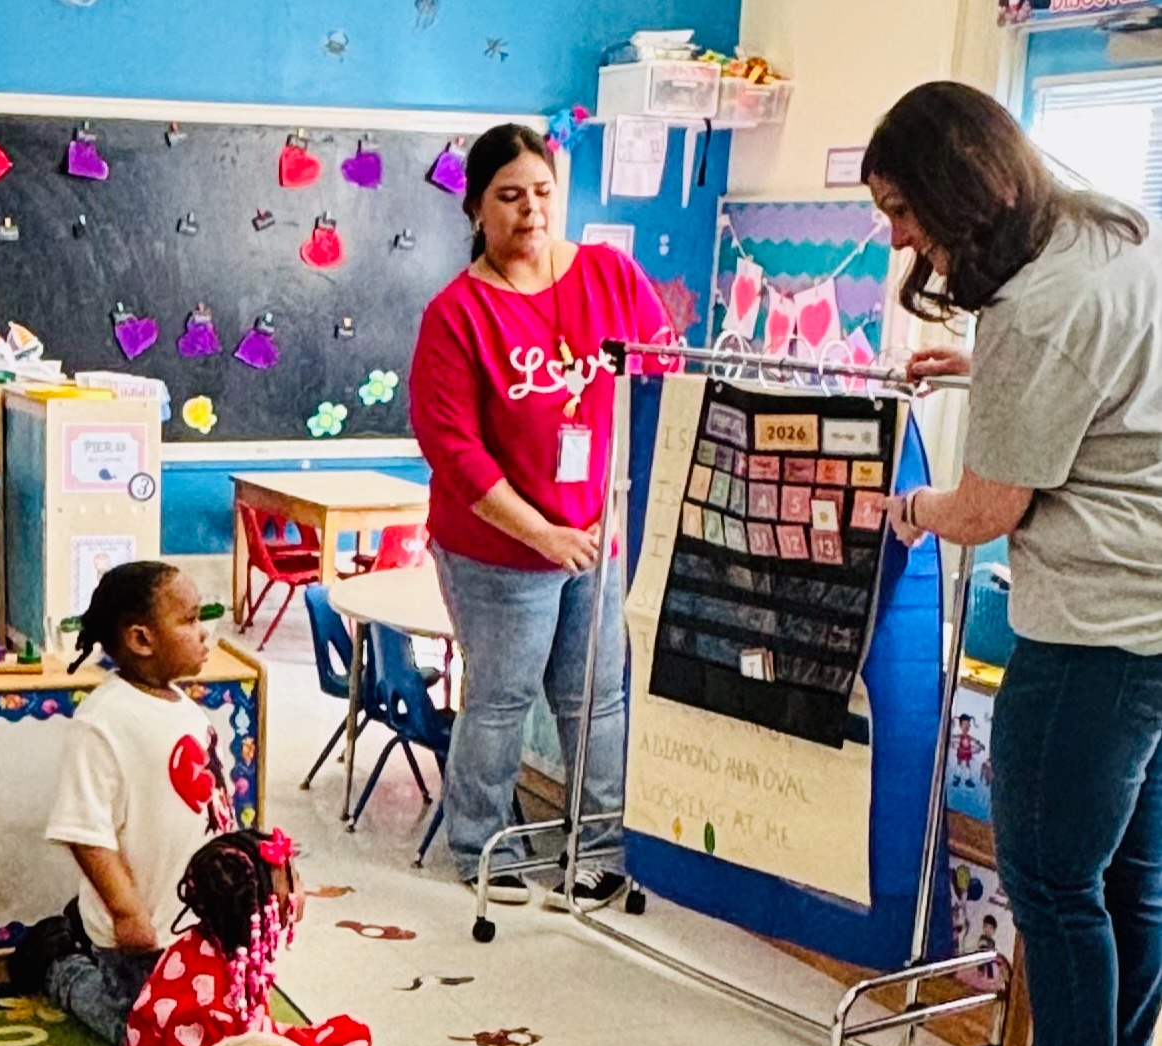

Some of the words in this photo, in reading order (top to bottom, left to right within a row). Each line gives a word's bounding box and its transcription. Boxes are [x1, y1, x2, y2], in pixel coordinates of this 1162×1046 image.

[766, 425, 806, 441] 2026
[84, 441, 114, 453] PIER
[137, 477, 150, 496] 3
[818, 539, 835, 558] 13
